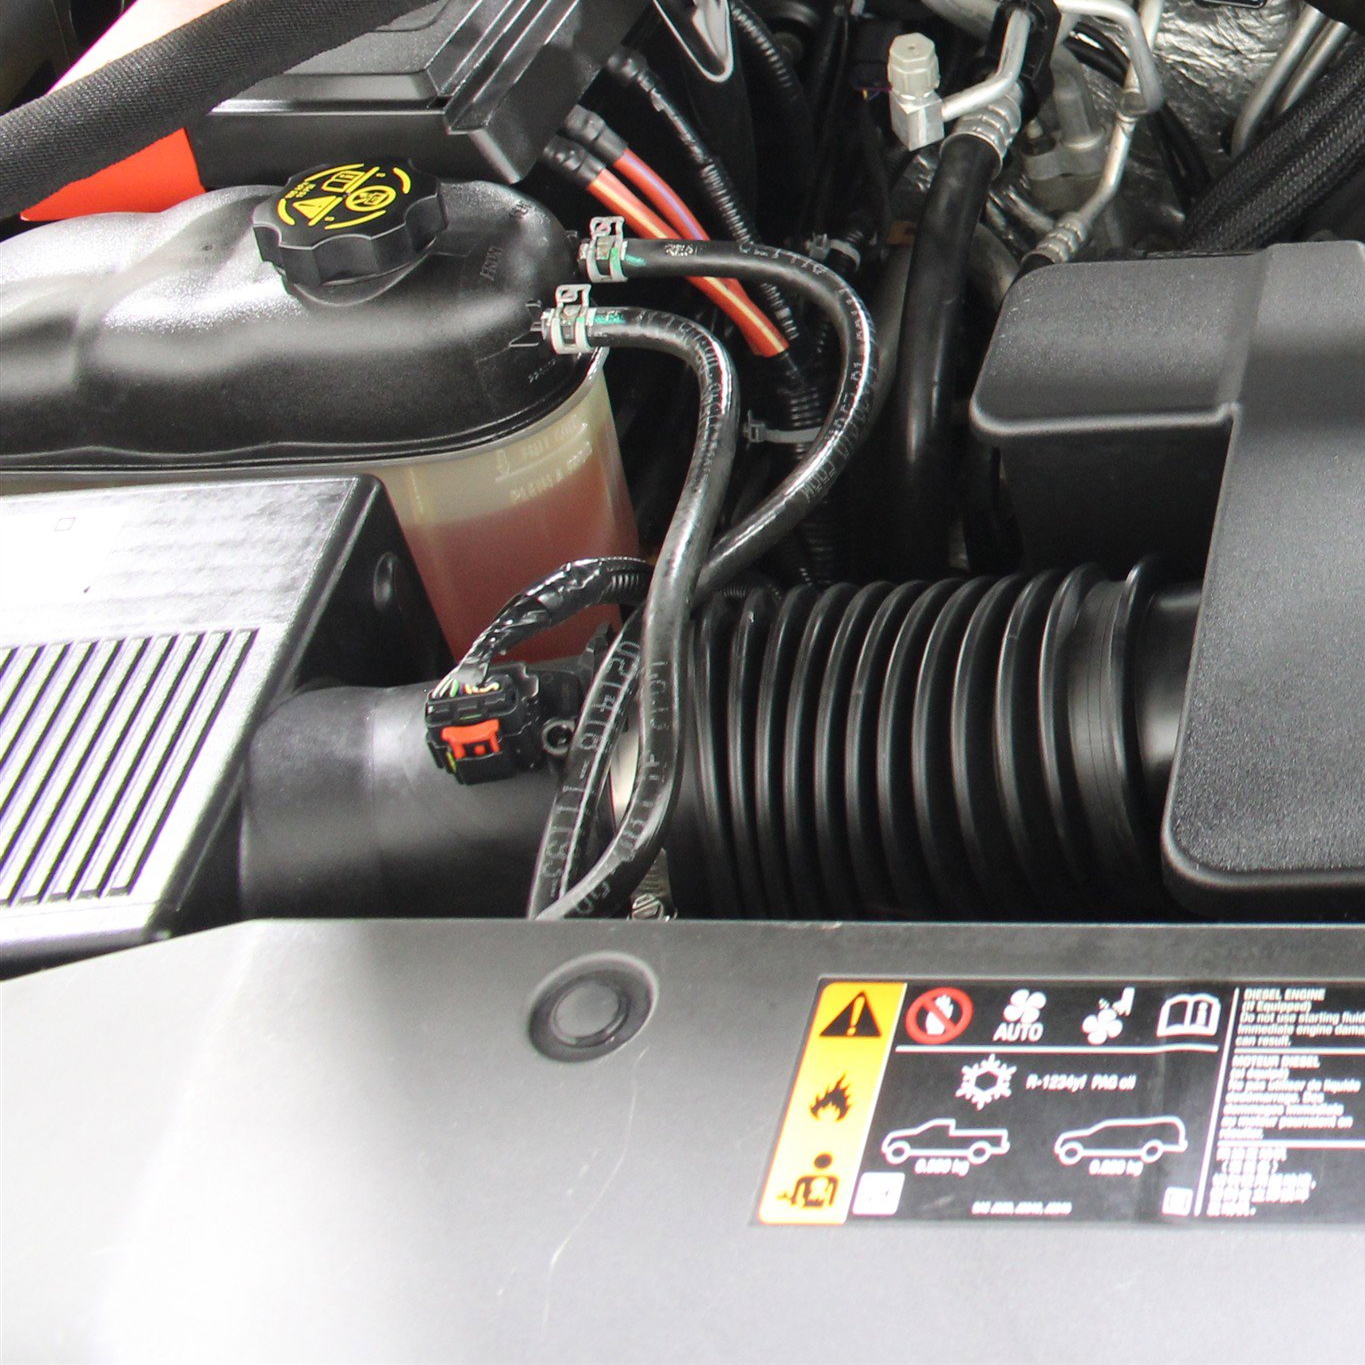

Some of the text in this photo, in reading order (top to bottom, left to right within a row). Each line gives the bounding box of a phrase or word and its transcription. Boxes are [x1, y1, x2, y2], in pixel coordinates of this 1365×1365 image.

[1243, 988, 1326, 1001] DIESEL ENGINE
[1256, 1012, 1275, 1023] not
[1276, 1013, 1297, 1023] use
[1298, 1011, 1340, 1025] starting
[992, 1022, 1043, 1042] AUTO
[1296, 1024, 1334, 1038] engine
[1235, 1036, 1257, 1046] can
